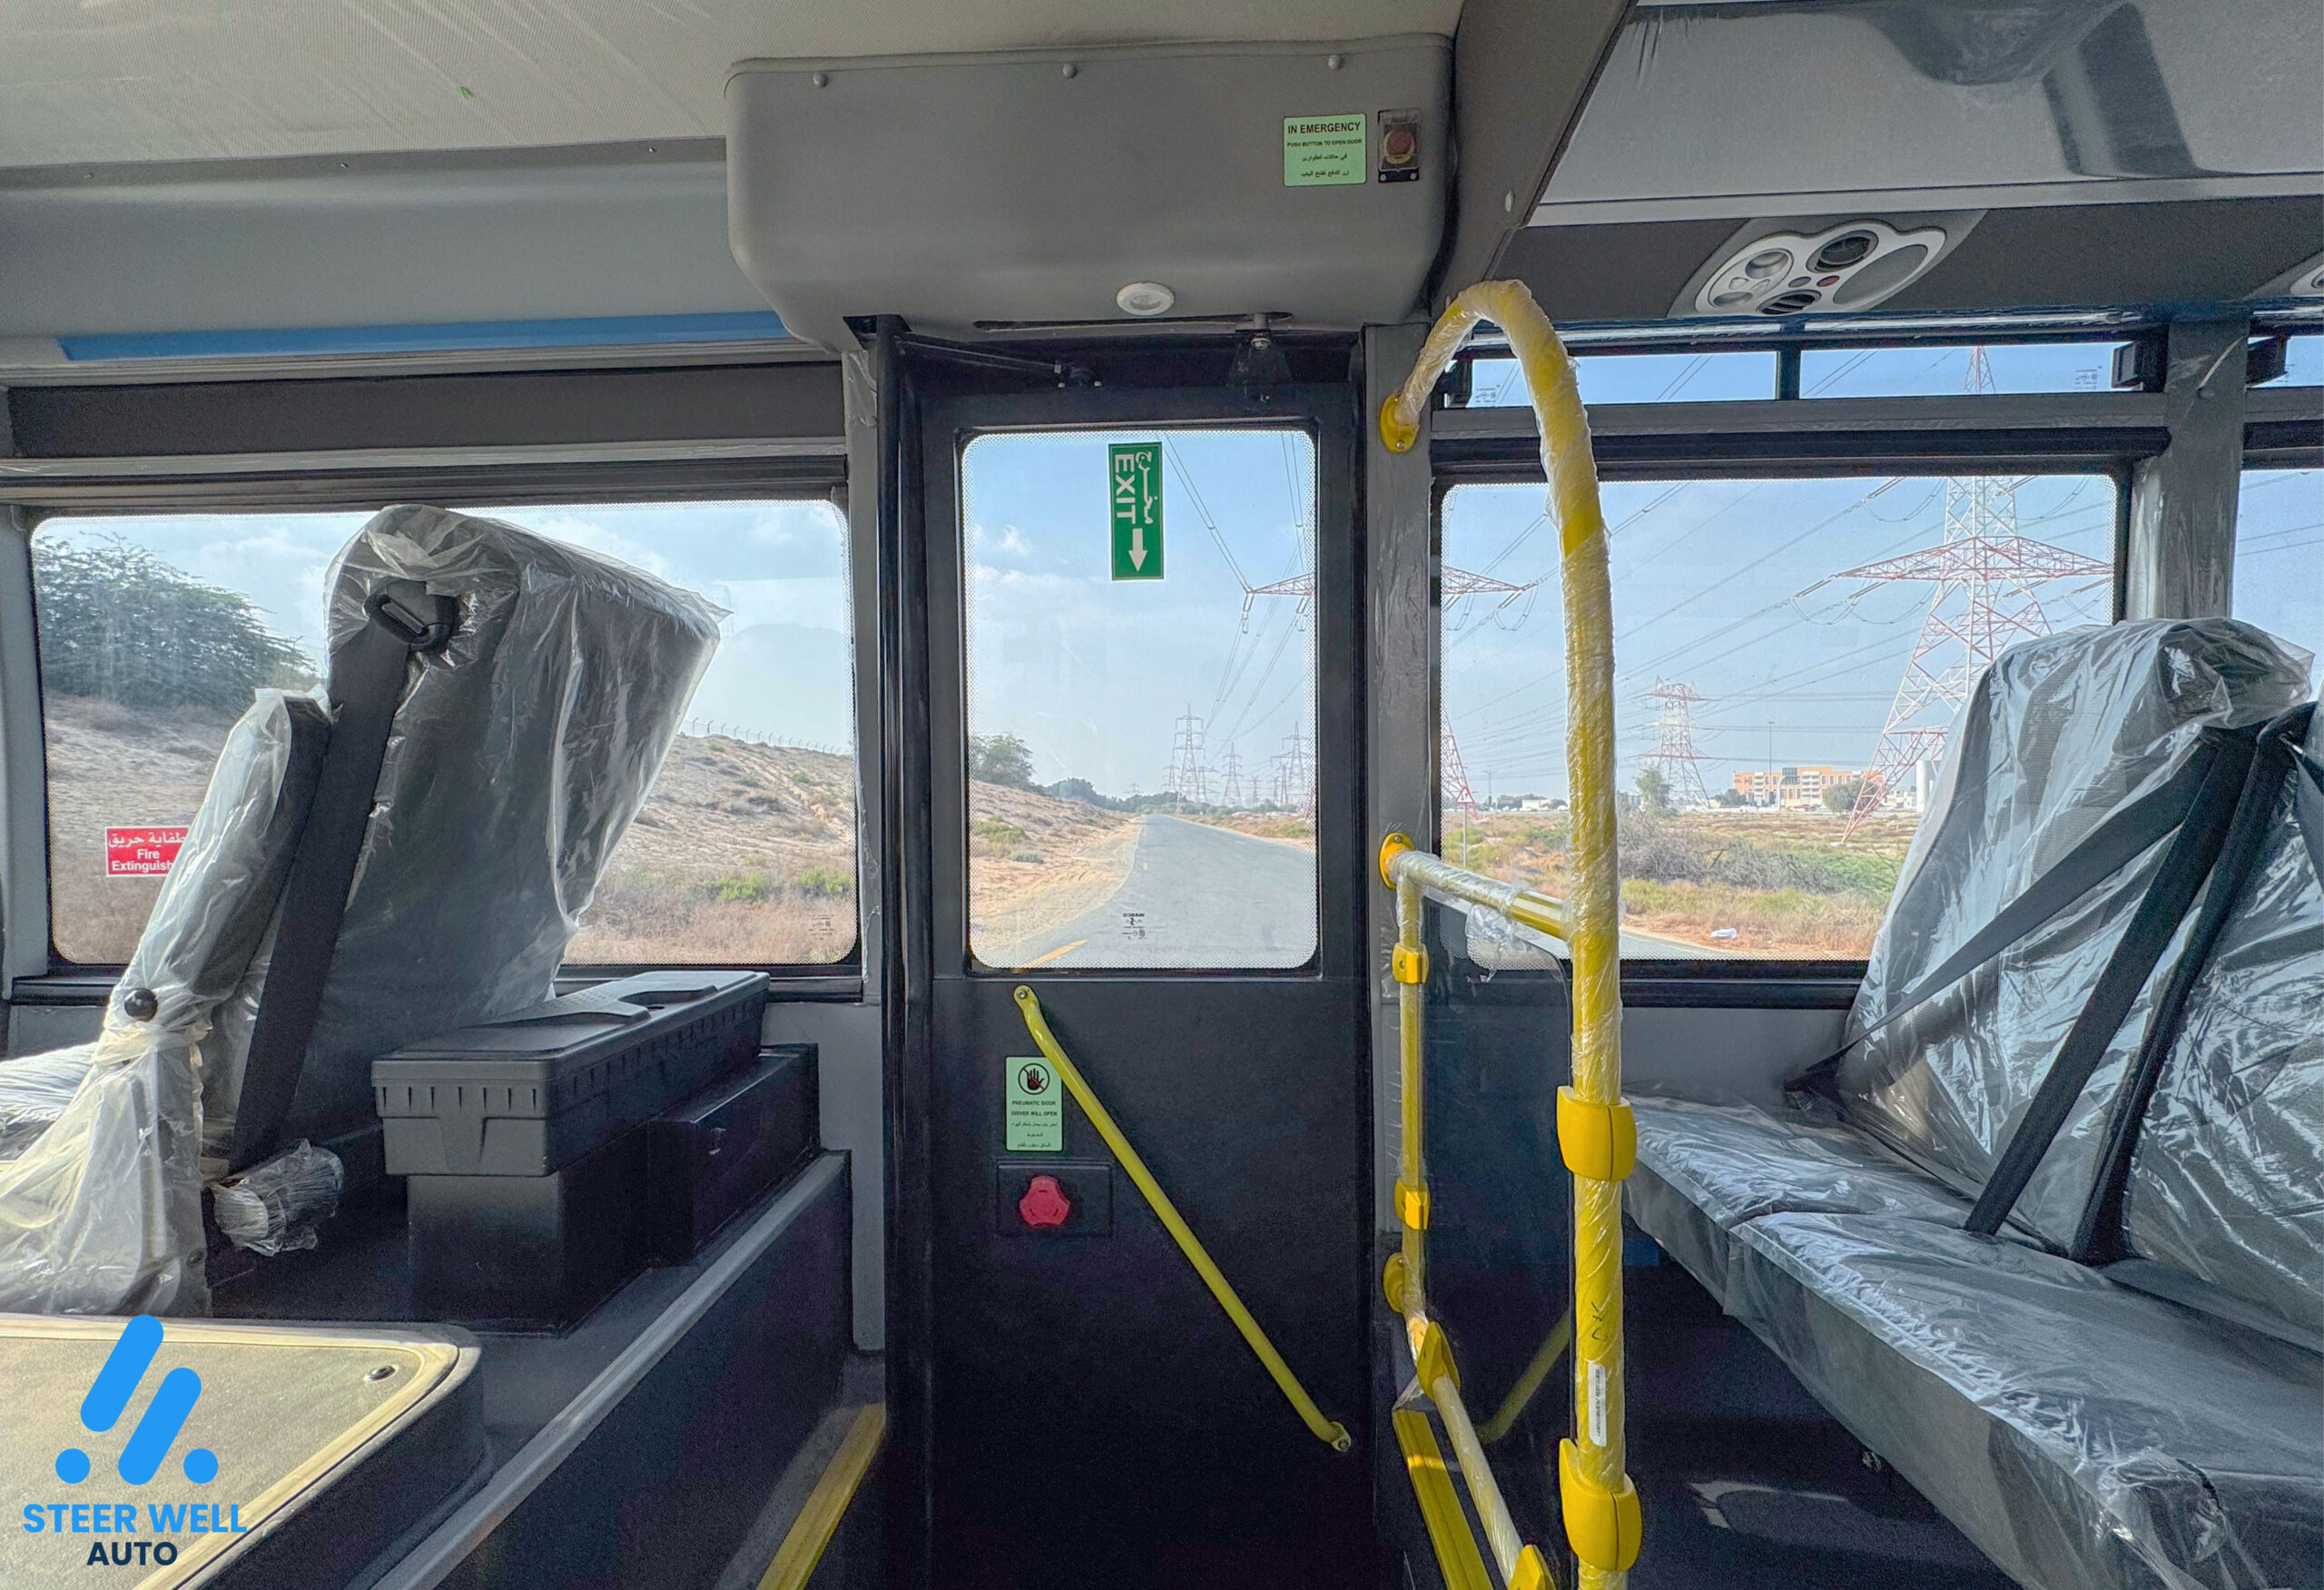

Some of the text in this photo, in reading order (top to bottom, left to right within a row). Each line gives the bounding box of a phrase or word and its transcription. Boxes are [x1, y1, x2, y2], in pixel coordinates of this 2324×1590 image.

[1287, 122, 1361, 134] IN EMERGENCY
[1115, 454, 1136, 524] EXIT
[1135, 451, 1158, 524] مخرج
[108, 833, 144, 847] حريق
[137, 849, 160, 859] Fire
[112, 860, 174, 873] Extinguish
